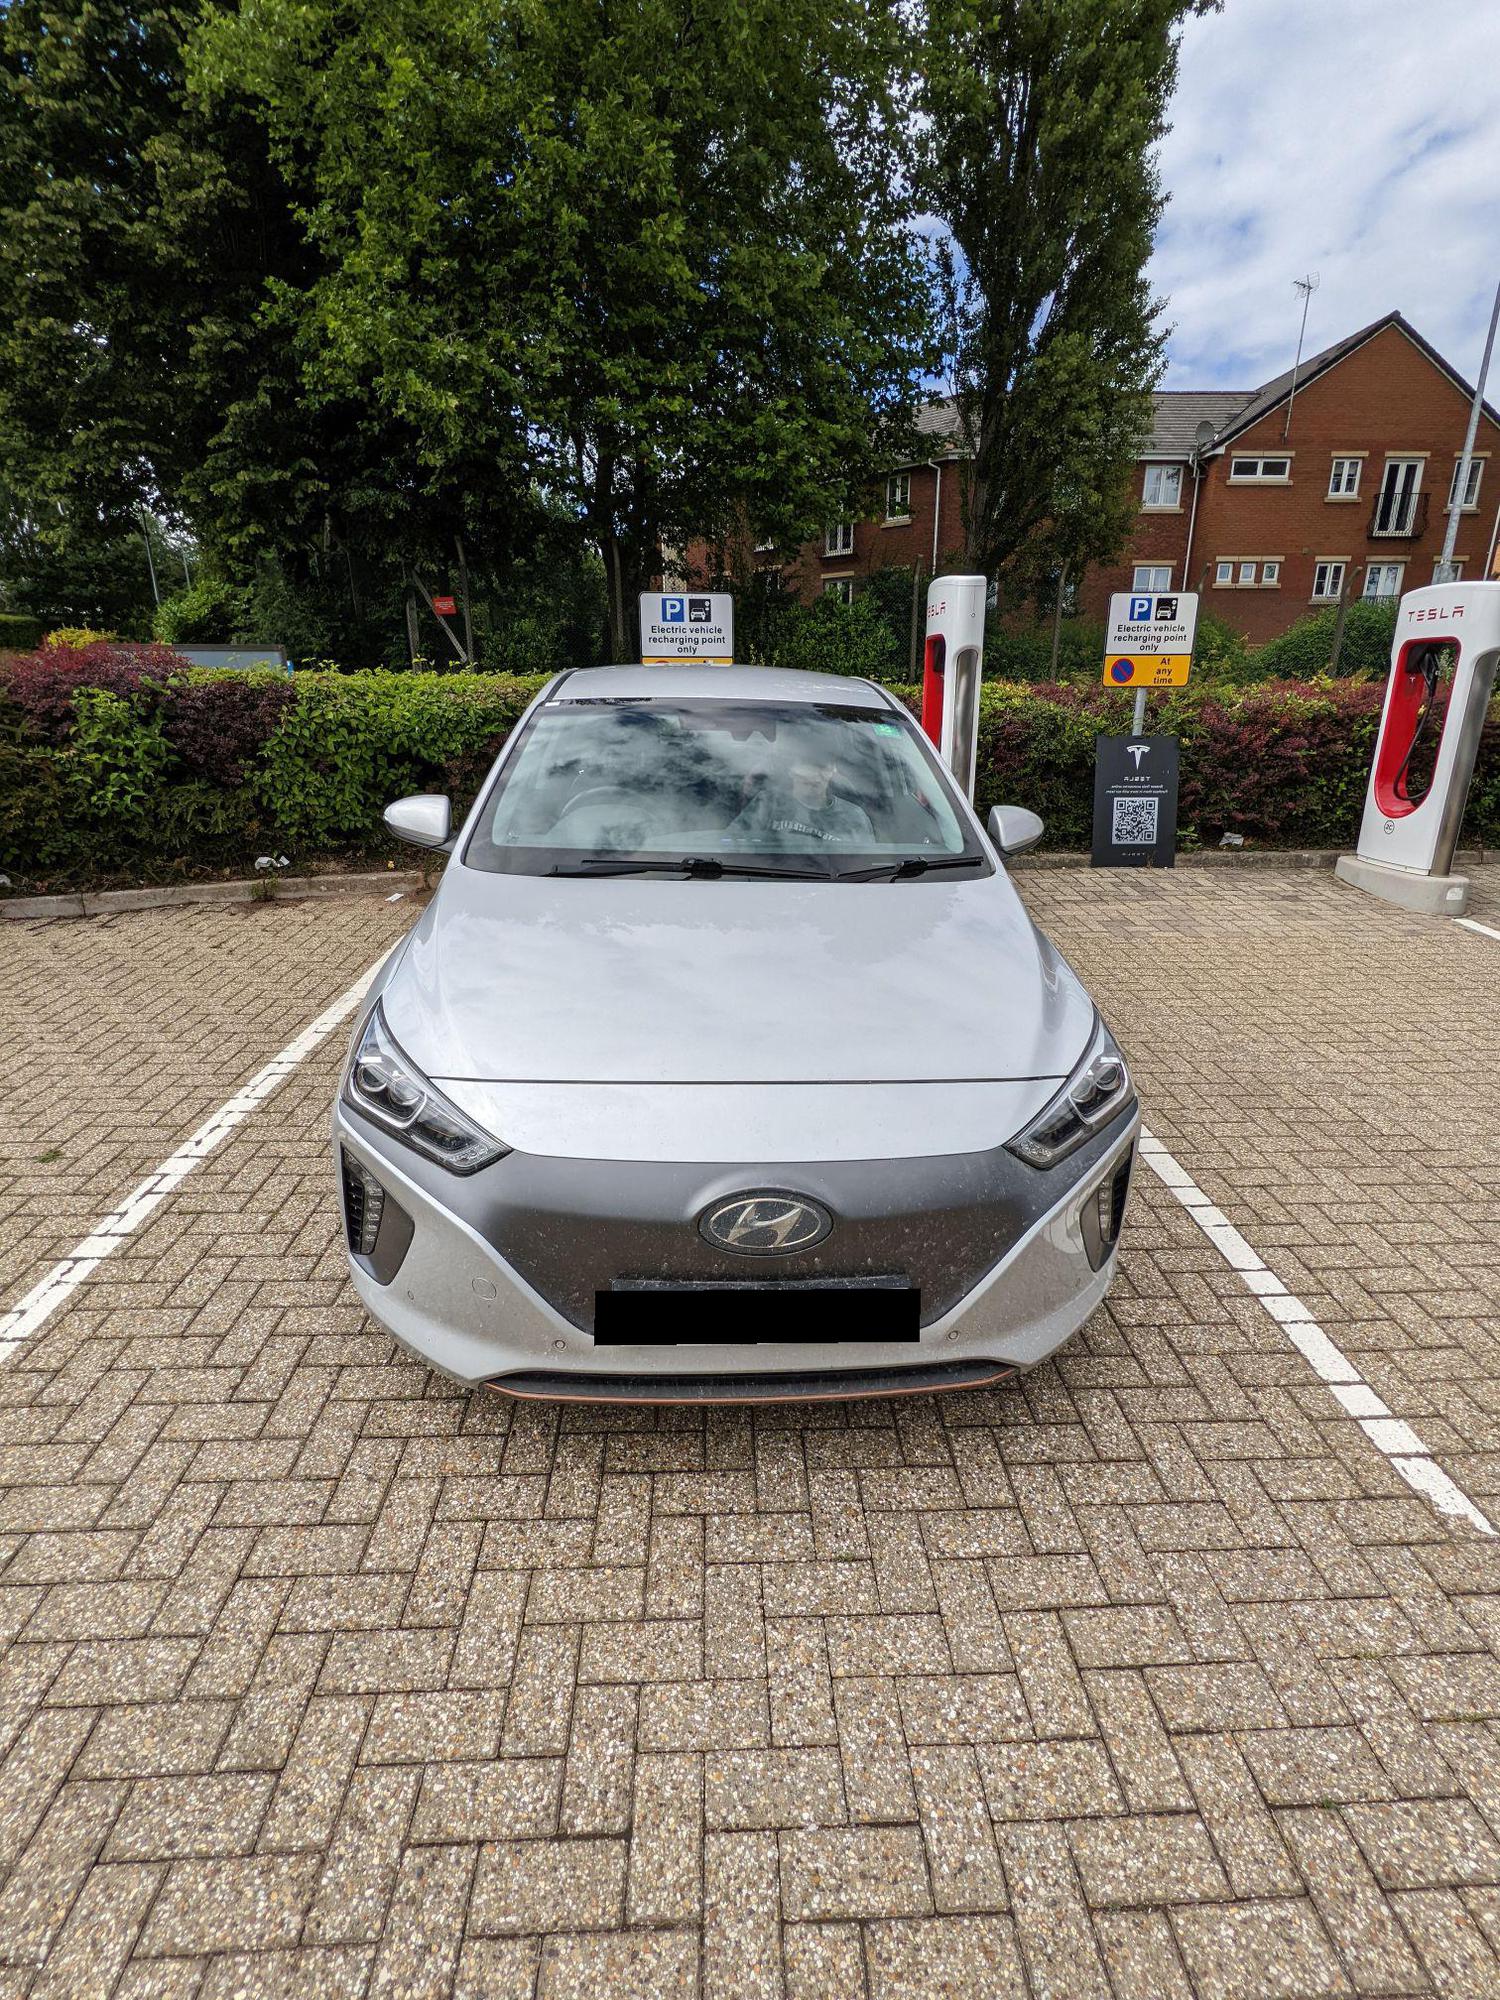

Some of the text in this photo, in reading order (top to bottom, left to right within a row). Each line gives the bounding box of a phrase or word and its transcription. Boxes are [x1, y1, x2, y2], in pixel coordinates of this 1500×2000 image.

[666, 600, 681, 620] P
[1133, 600, 1149, 619] P
[1408, 605, 1465, 622] TESLA
[651, 625, 723, 634] Electric vehicle
[1117, 624, 1186, 632] Electric vehicle
[648, 635, 726, 645] recharging point
[1113, 634, 1187, 643] recharging point
[677, 645, 697, 655] only
[1139, 644, 1159, 652] only
[1160, 657, 1171, 665] At
[1156, 667, 1172, 676] any
